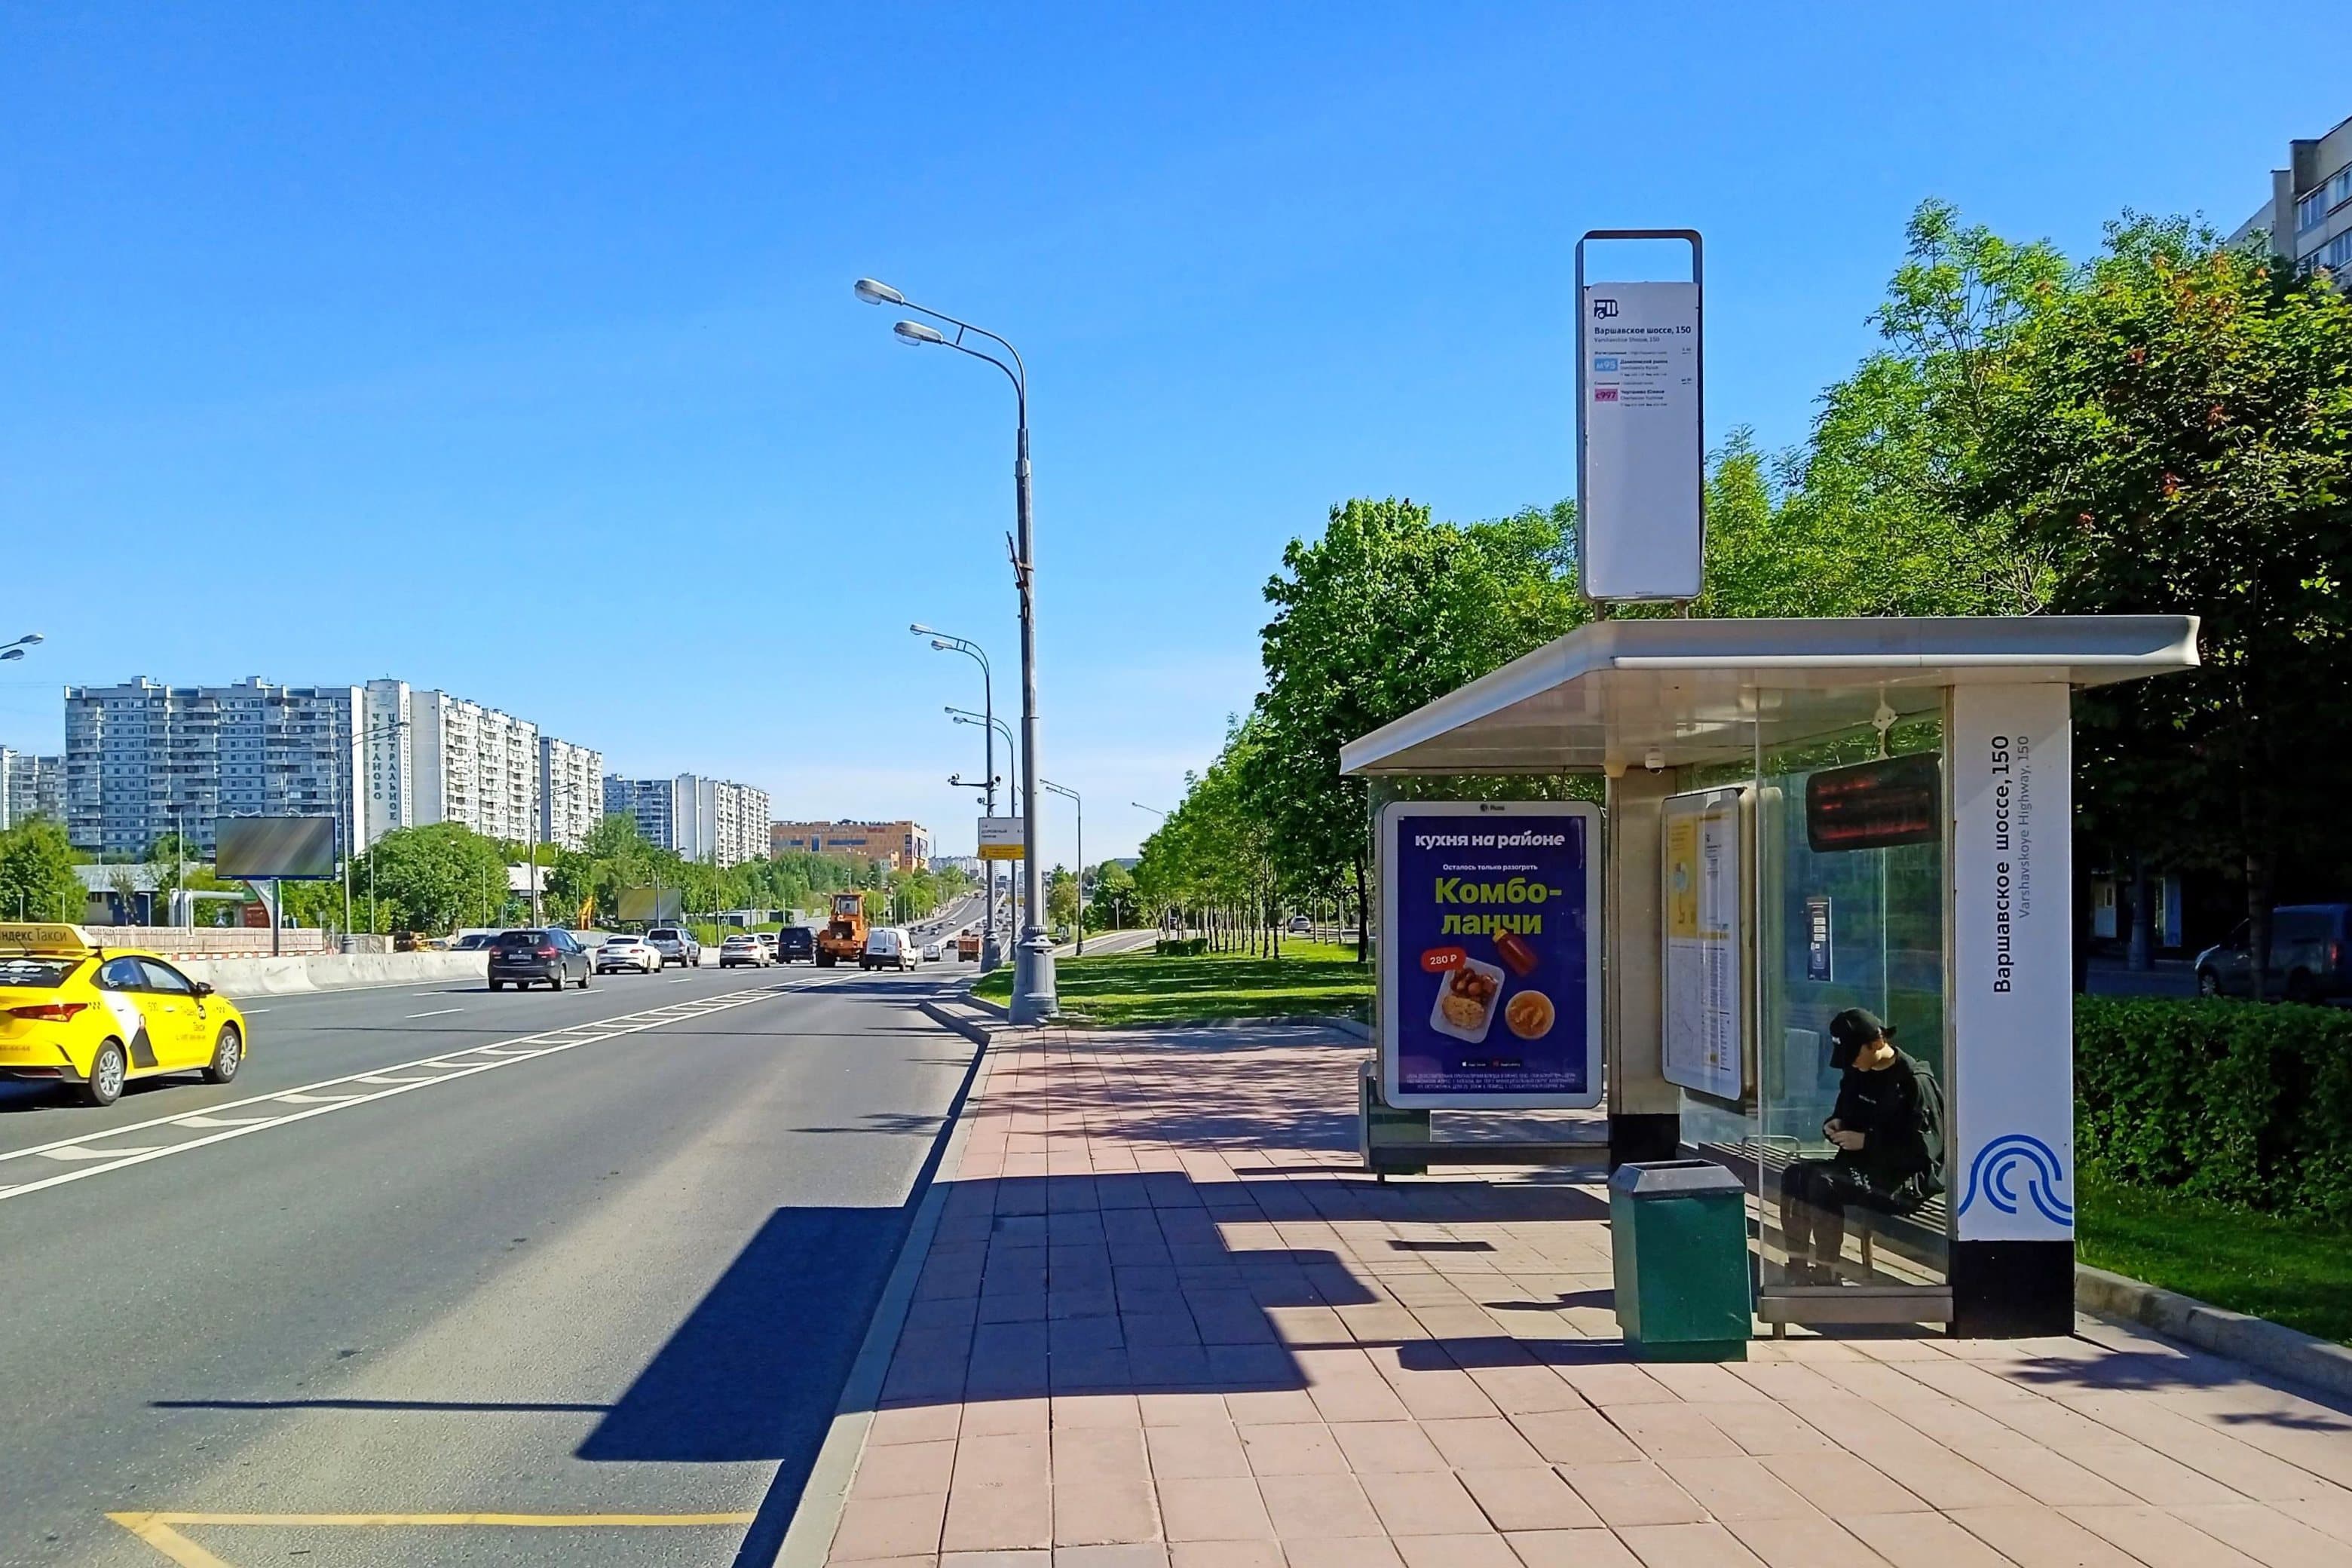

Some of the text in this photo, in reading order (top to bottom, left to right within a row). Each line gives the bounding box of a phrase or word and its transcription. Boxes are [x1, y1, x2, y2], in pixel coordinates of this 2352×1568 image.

[1594, 326, 1645, 335] Варшавское
[1676, 326, 1691, 334] 150
[2017, 736, 2032, 919] Varshavskoye Highway, 150
[1414, 830, 1566, 850] кухня на районе
[1991, 735, 2014, 994] Варшавское шоссе, 150
[1435, 877, 1562, 904] Комбо-
[0, 927, 67, 942] ндекс Такси
[1441, 914, 1542, 935] ланчи
[1429, 955, 1448, 965] 280
